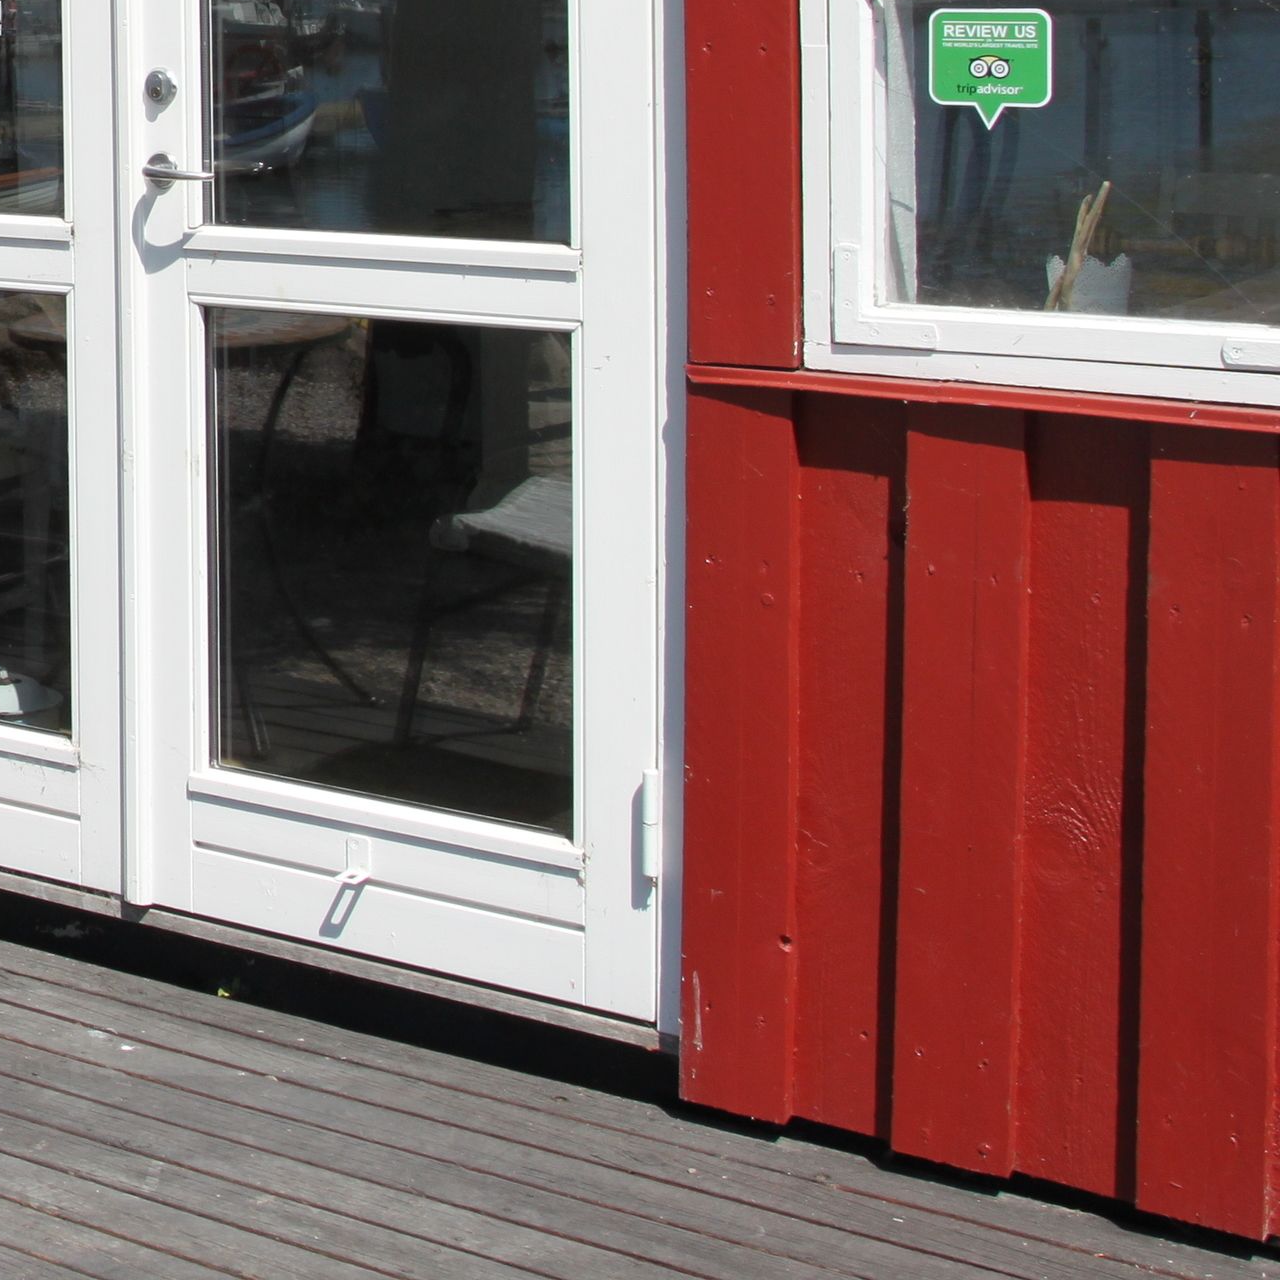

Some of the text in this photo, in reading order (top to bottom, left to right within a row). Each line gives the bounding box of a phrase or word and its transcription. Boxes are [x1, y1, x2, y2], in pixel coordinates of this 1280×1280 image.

[943, 24, 1036, 38] REVIEW US
[956, 83, 1020, 96] tripadvisor
